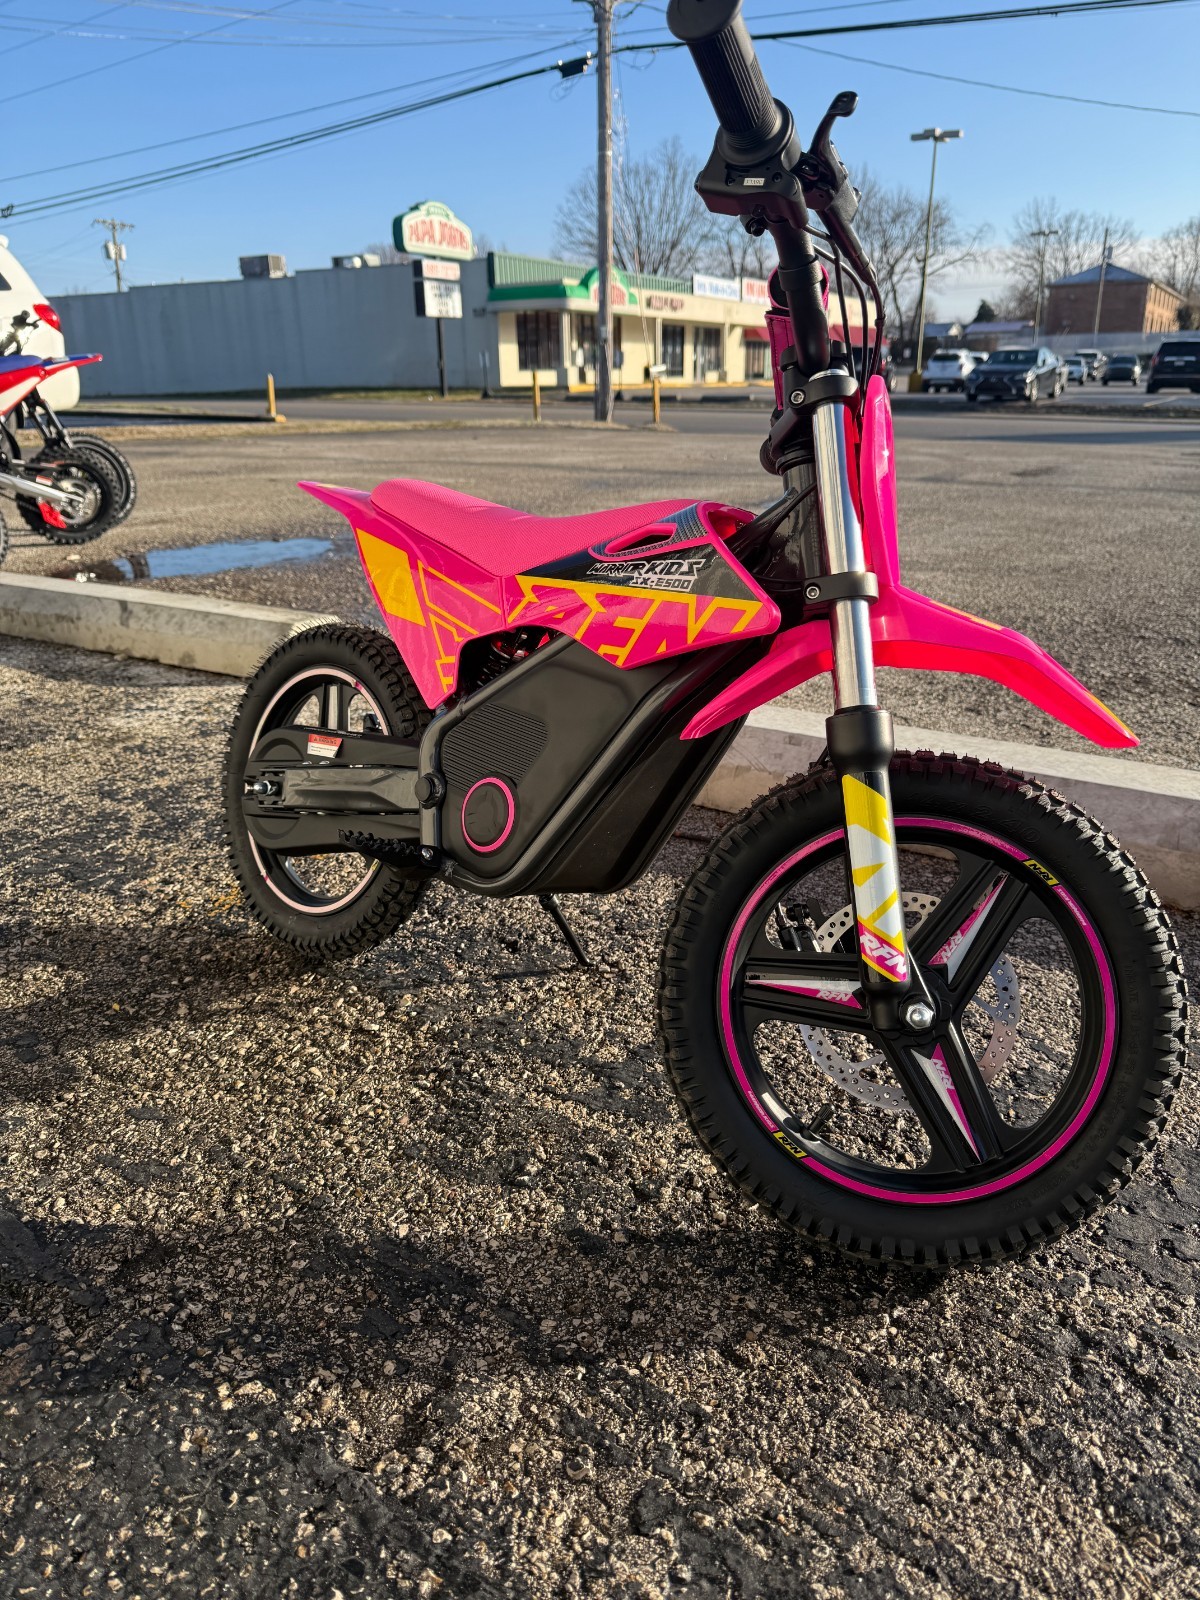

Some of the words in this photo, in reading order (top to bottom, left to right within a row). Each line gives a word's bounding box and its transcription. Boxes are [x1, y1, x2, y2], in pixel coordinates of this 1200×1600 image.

[643, 559, 706, 578] KIDS
[632, 576, 693, 591] SX-E500
[1028, 863, 1053, 882] RFN
[859, 930, 907, 975] RFN
[940, 929, 963, 963] RFN
[815, 990, 853, 1002] RFN
[931, 1058, 956, 1091] RFN
[778, 1134, 802, 1154] RFN
